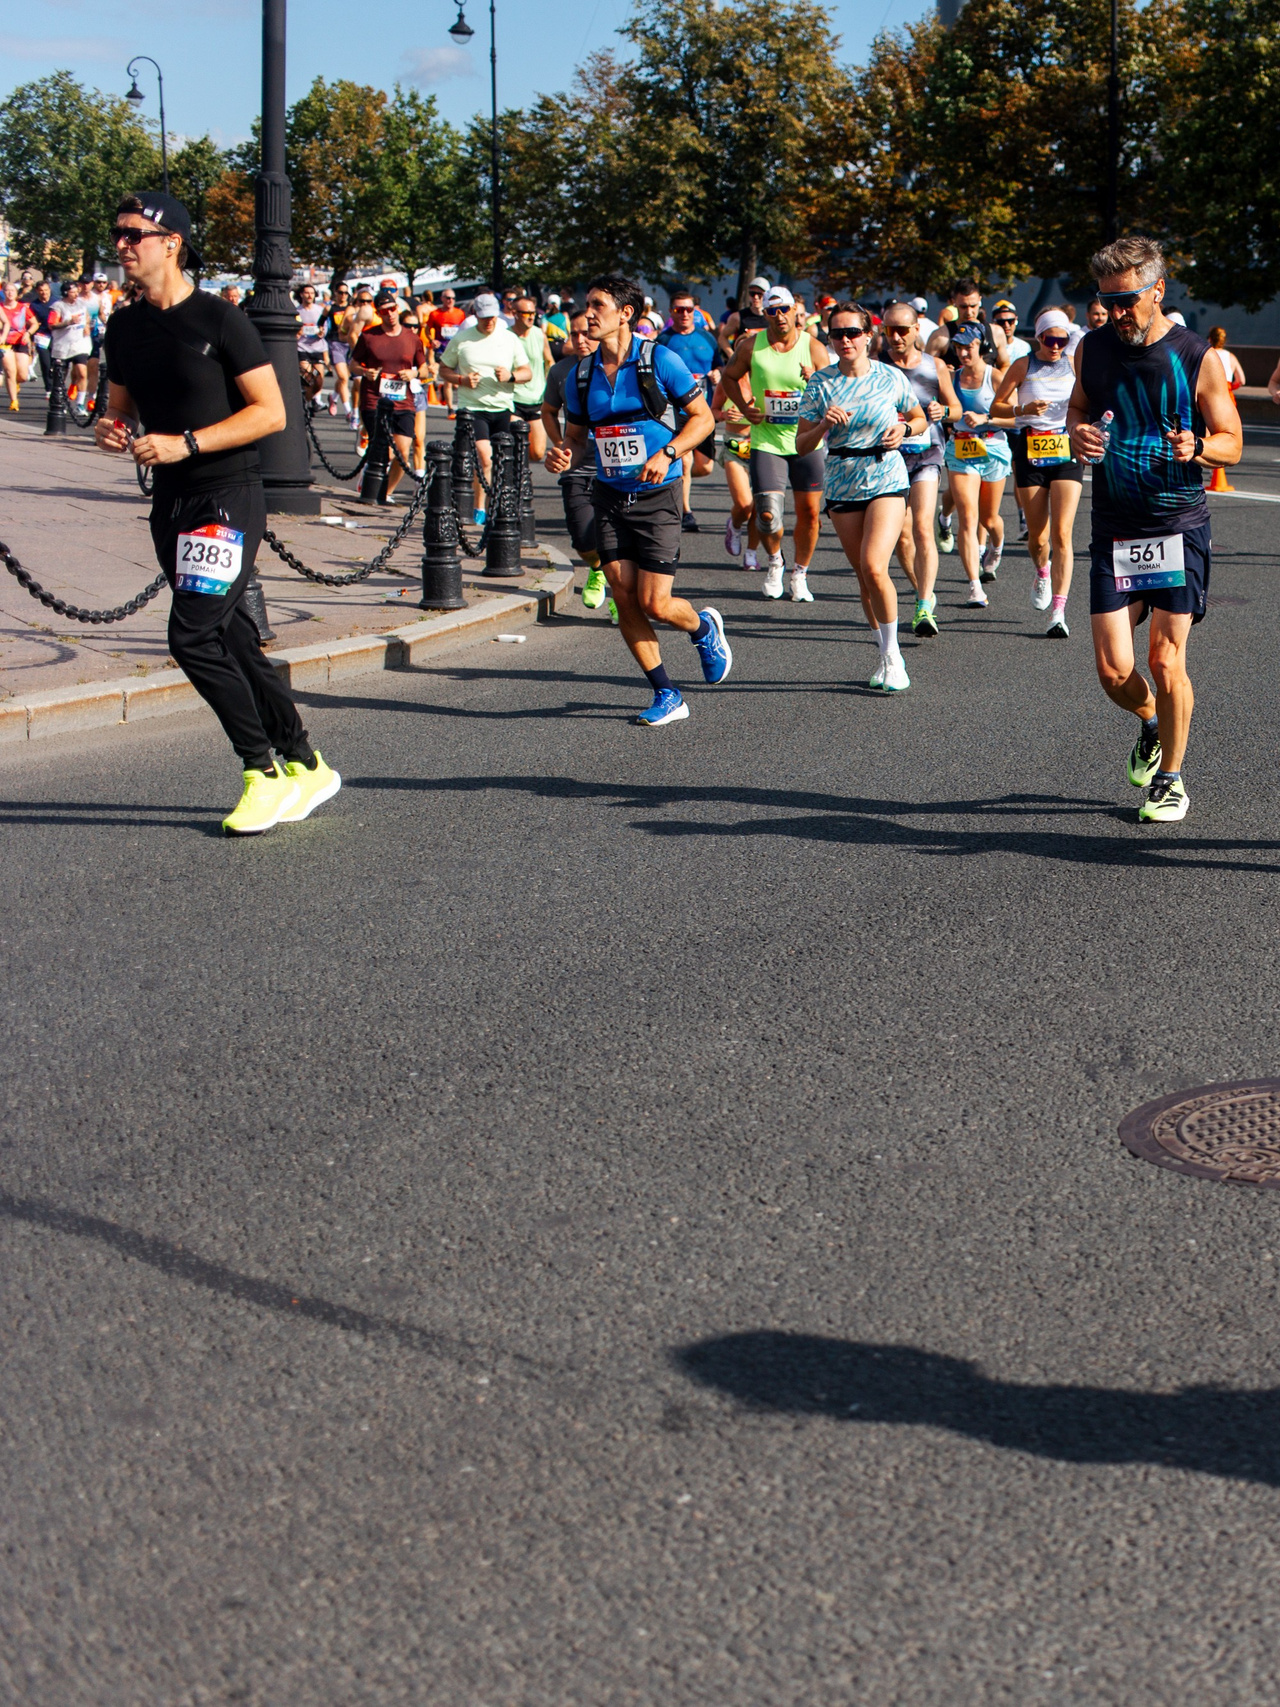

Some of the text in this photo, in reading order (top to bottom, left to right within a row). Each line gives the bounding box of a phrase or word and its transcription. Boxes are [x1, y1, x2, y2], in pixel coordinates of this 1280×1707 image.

[770, 399, 799, 412] 1133
[604, 440, 639, 458] 6215
[961, 441, 977, 452] 417
[1033, 437, 1064, 452] 5234
[611, 456, 632, 464] ВИТАЛИЙ
[182, 540, 233, 569] 2383
[1129, 541, 1165, 563] 561
[190, 564, 216, 574] РОМАН
[1137, 563, 1161, 571] РОМАН
[1122, 577, 1132, 589] D
